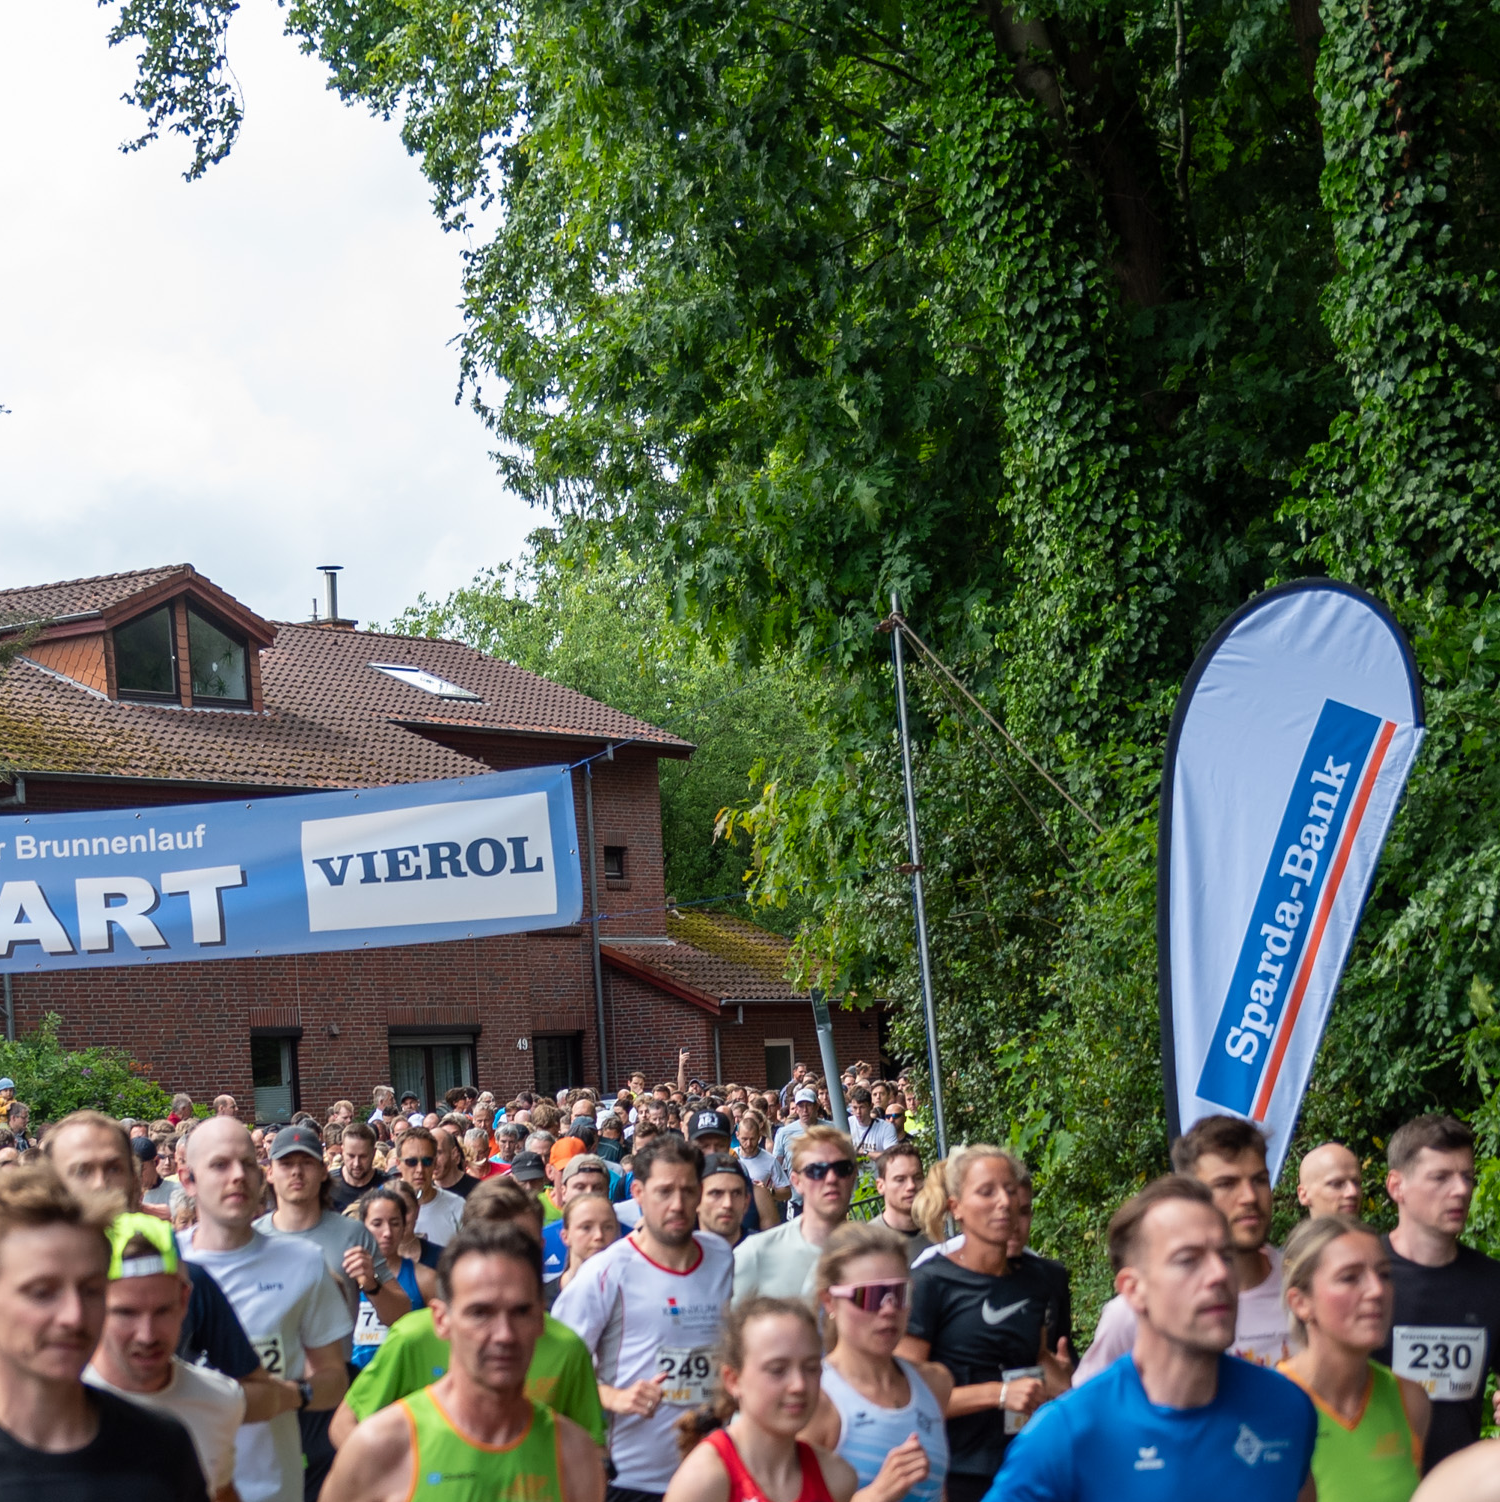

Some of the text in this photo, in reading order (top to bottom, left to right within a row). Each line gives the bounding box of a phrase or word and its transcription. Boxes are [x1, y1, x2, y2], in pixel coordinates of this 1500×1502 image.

[16, 824, 206, 860] Brunnenlauf
[312, 836, 544, 887] VIEROL
[1226, 755, 1351, 1065] Sparda-Bank
[660, 1355, 710, 1380] 249
[1408, 1343, 1472, 1370] 230
